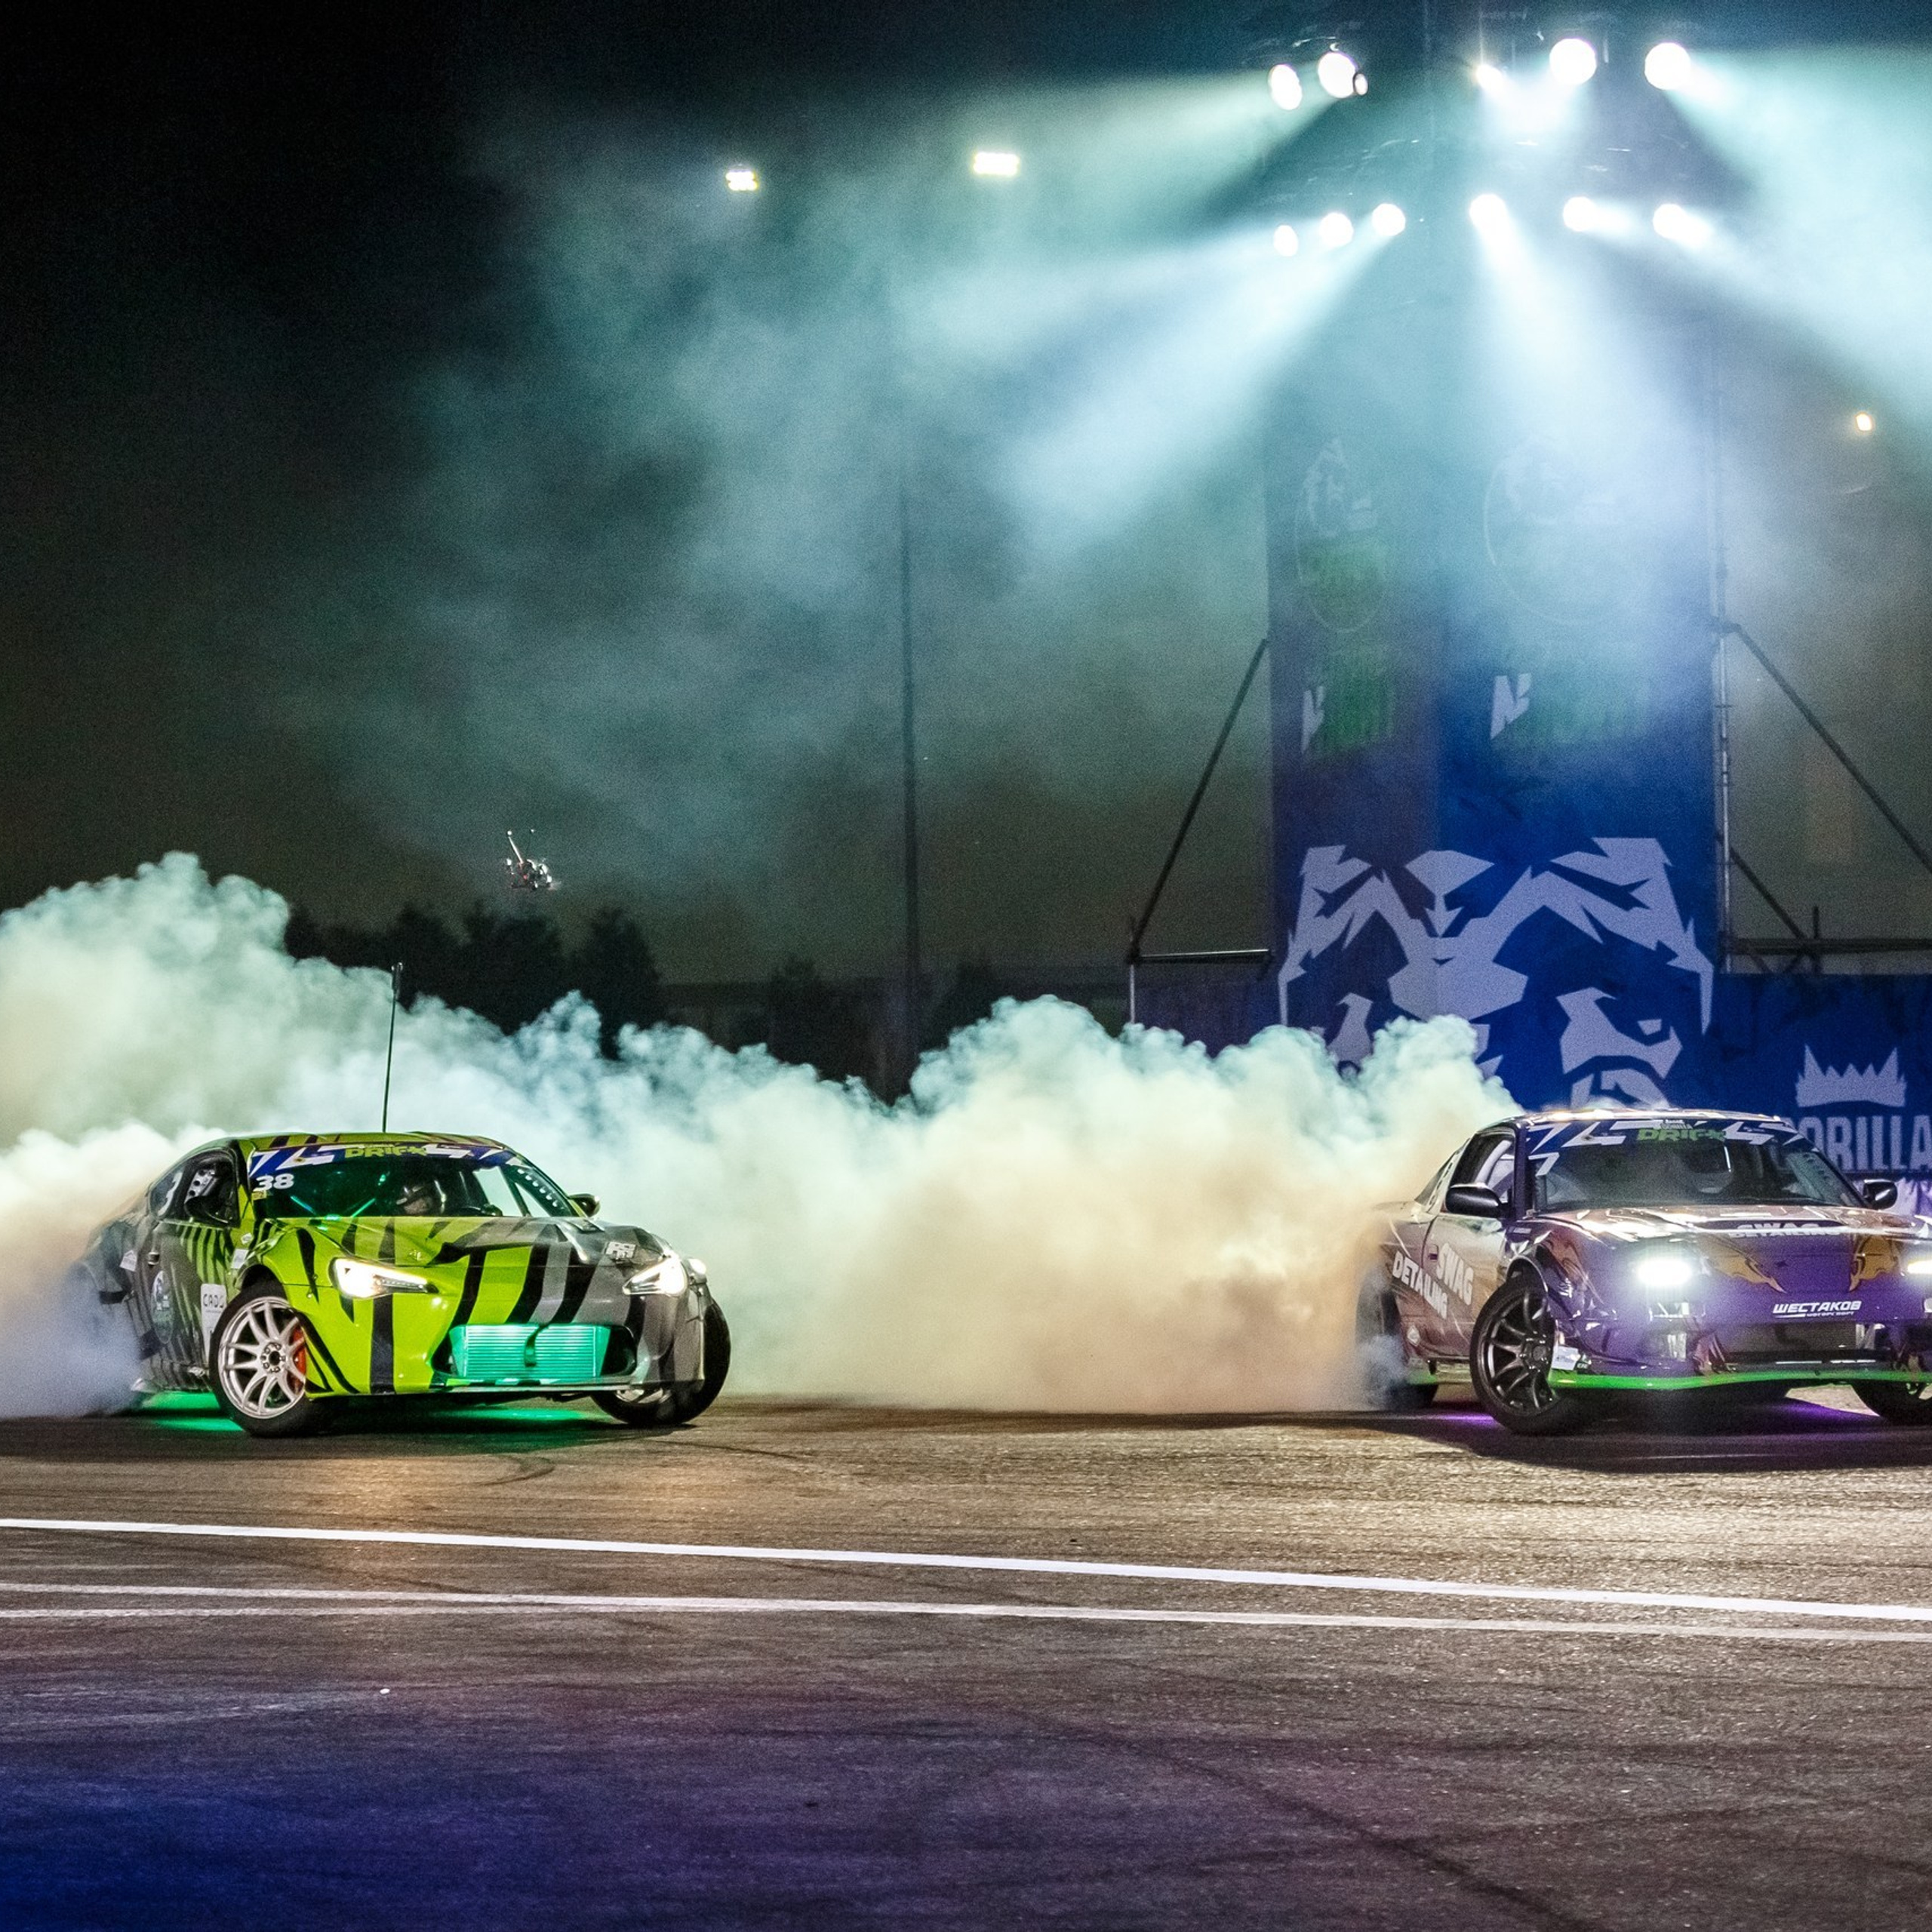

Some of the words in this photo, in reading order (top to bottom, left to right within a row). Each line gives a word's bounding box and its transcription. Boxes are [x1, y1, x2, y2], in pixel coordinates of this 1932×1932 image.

[1783, 1116, 1932, 1171] ORILLA
[253, 1173, 295, 1192] 38
[1392, 1251, 1448, 1319] DETAILING
[1436, 1243, 1473, 1306] SWAG
[1773, 1300, 1862, 1314] ШЕСТАКОВ
